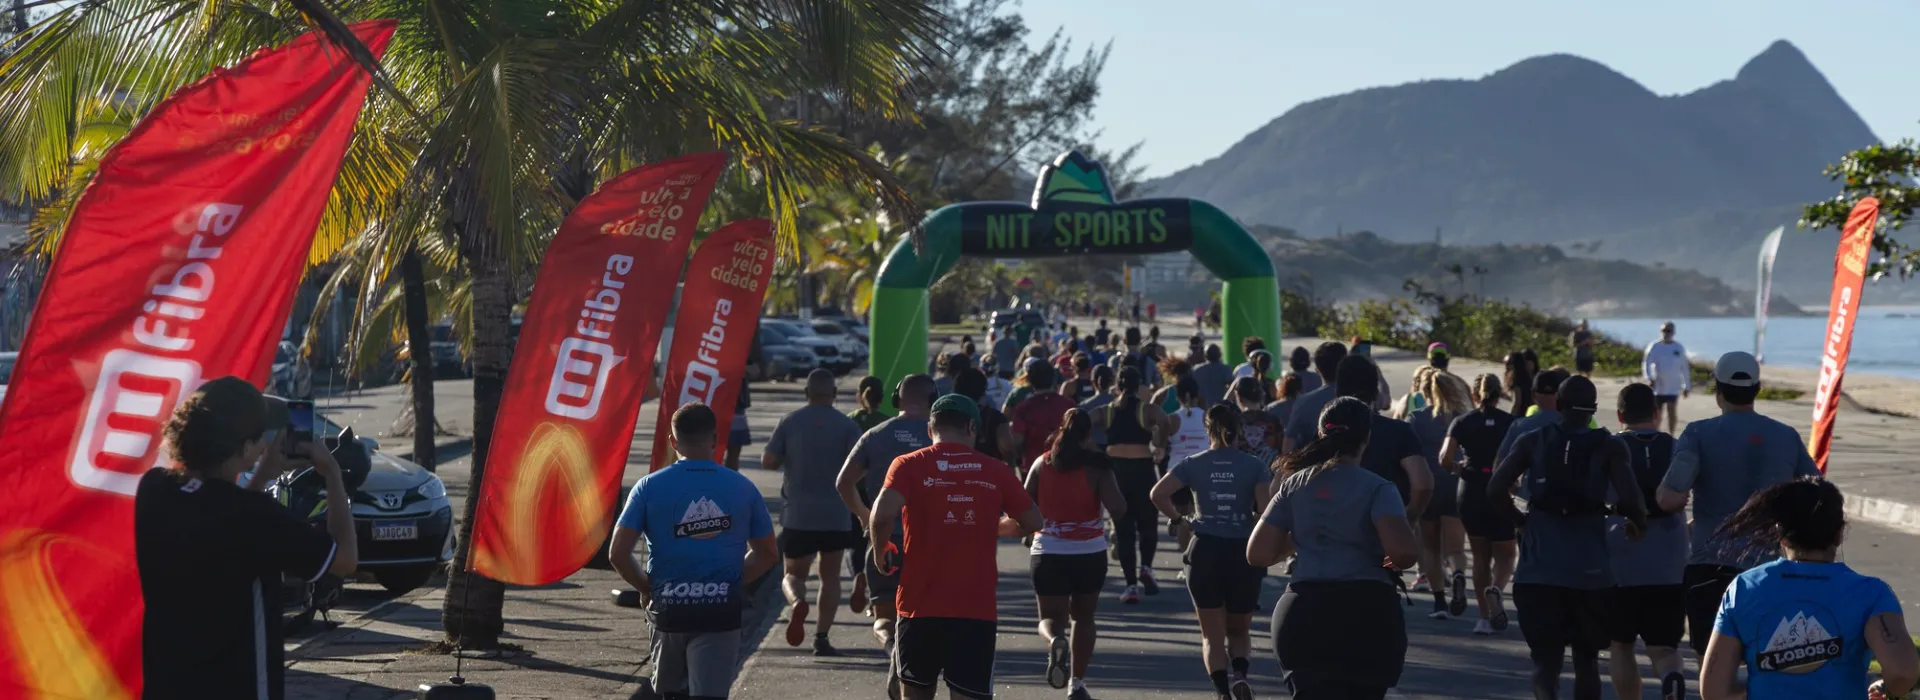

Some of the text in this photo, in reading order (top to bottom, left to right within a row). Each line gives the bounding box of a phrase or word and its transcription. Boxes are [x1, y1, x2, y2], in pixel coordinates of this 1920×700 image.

[600, 218, 677, 241] cidade
[986, 208, 1167, 249] NIT SPORTS
[733, 240, 769, 261] ultra
[732, 256, 763, 276] velo
[711, 264, 759, 292] cidade
[687, 518, 721, 532] LOBOS
[660, 581, 731, 598] LOBOS
[1773, 643, 1826, 664] LOBOS
